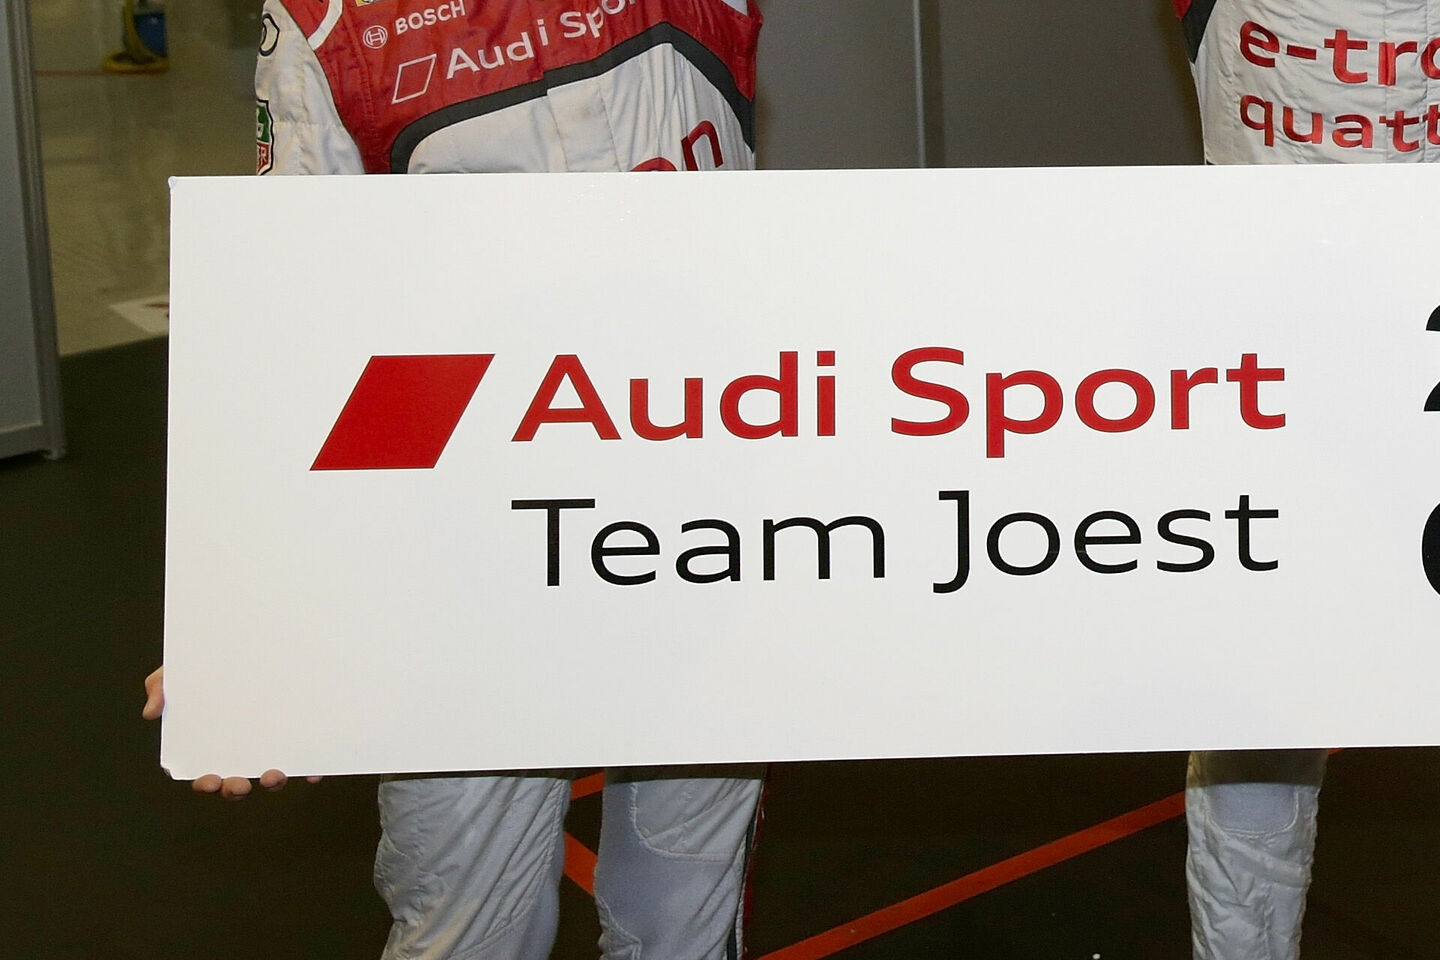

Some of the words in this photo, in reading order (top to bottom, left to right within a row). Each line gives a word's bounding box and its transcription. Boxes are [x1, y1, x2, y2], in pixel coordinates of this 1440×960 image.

[446, 19, 549, 80] Audi
[510, 350, 836, 443] Audi
[890, 346, 1286, 459] Sport
[510, 498, 886, 587] Team
[932, 489, 1279, 594] Joest
